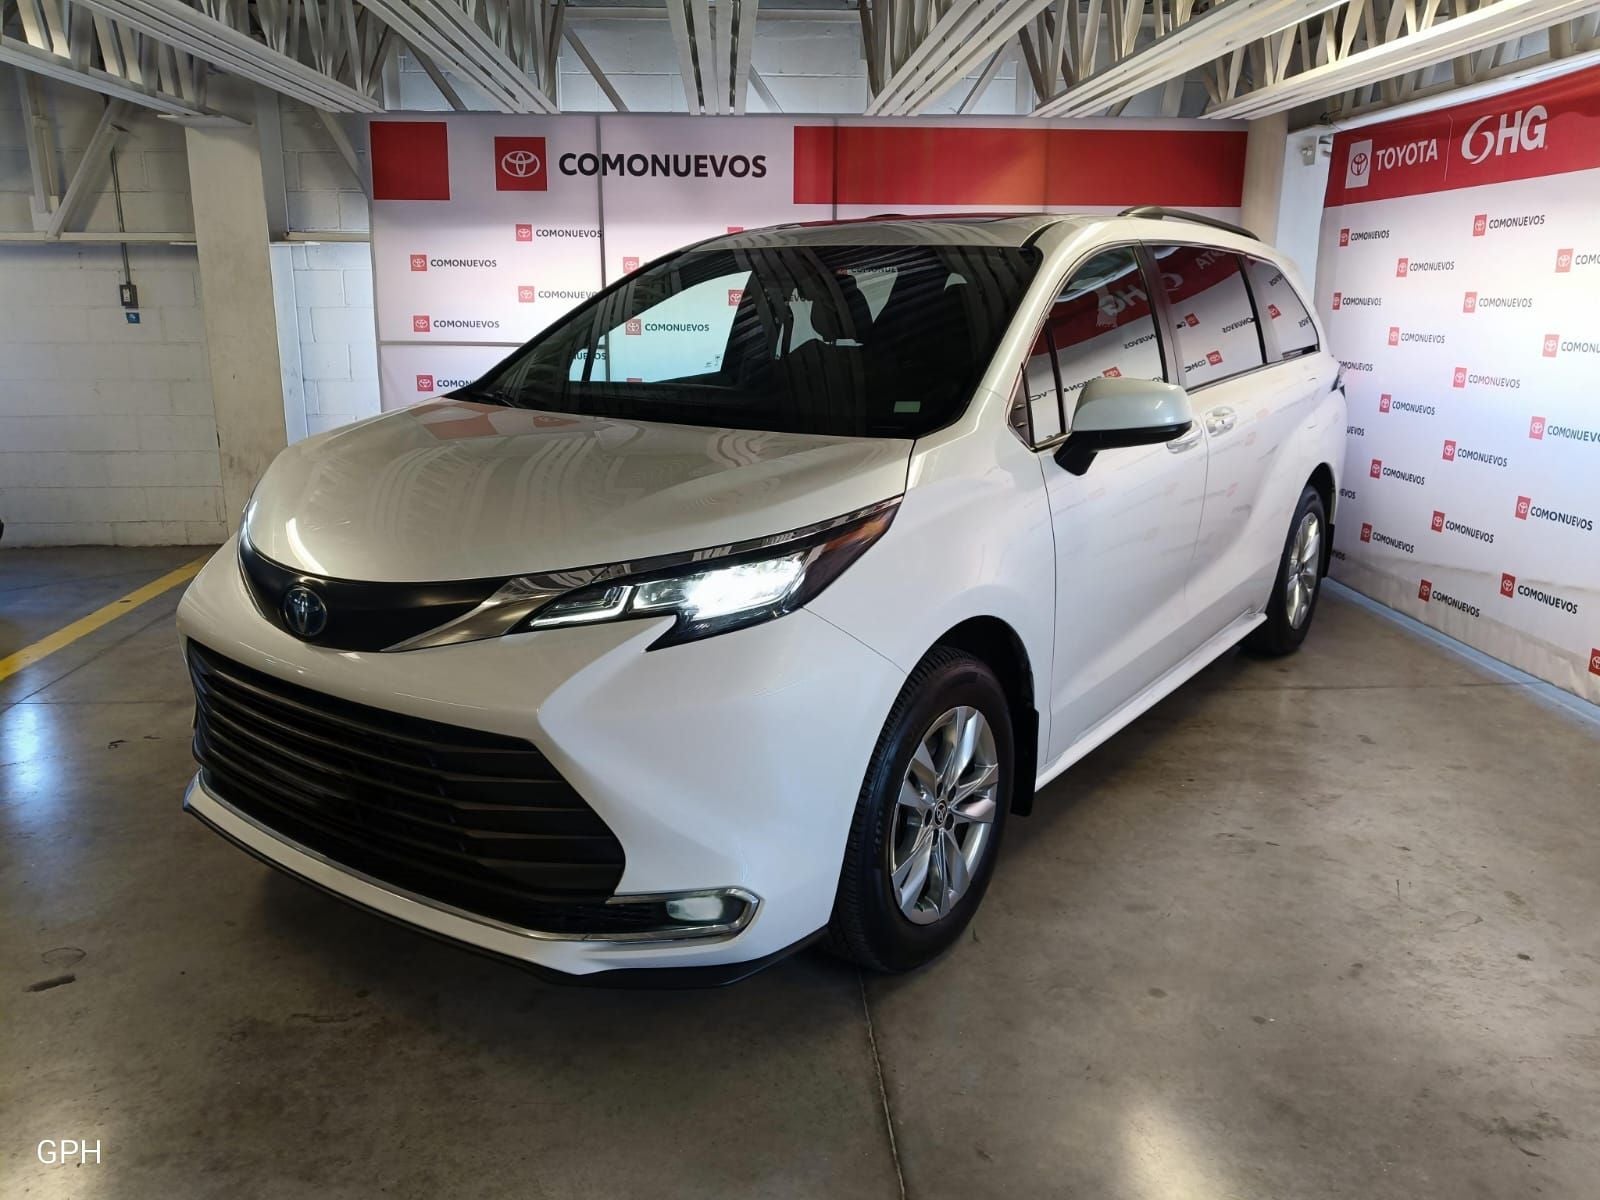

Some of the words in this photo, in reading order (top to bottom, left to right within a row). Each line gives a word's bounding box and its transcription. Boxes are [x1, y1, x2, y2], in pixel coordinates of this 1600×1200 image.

[1376, 138, 1438, 171] TOYOTA
[559, 153, 767, 178] COMONUEVOS
[1488, 214, 1545, 229] COMONUEVOS
[536, 229, 603, 238] COMONUEVOS
[1350, 230, 1390, 241] COMONUEVOS
[430, 259, 497, 268] COMONUEVOS
[1409, 261, 1455, 272] COMONUEVOS
[1342, 297, 1382, 306] COMONUEVOS
[1479, 297, 1533, 308] COMONUEVOS
[433, 320, 500, 329] COMONUEVOS
[645, 323, 710, 332] COMONUEVOS
[1400, 332, 1446, 344] COMONUEVOS
[1468, 374, 1521, 389] COMONUEVOS
[1392, 400, 1436, 416] COMONUEVOS
[1457, 448, 1508, 467] COMONUEVOS
[1382, 467, 1425, 485] COMONUEVOS
[1530, 506, 1593, 531] COMONUEVOS
[1445, 520, 1495, 544] COMONUEVOS
[1372, 531, 1415, 554] COMONUEVOS
[1432, 590, 1480, 618] COMONUEVOS
[1517, 584, 1578, 615] COMONUEVOS
